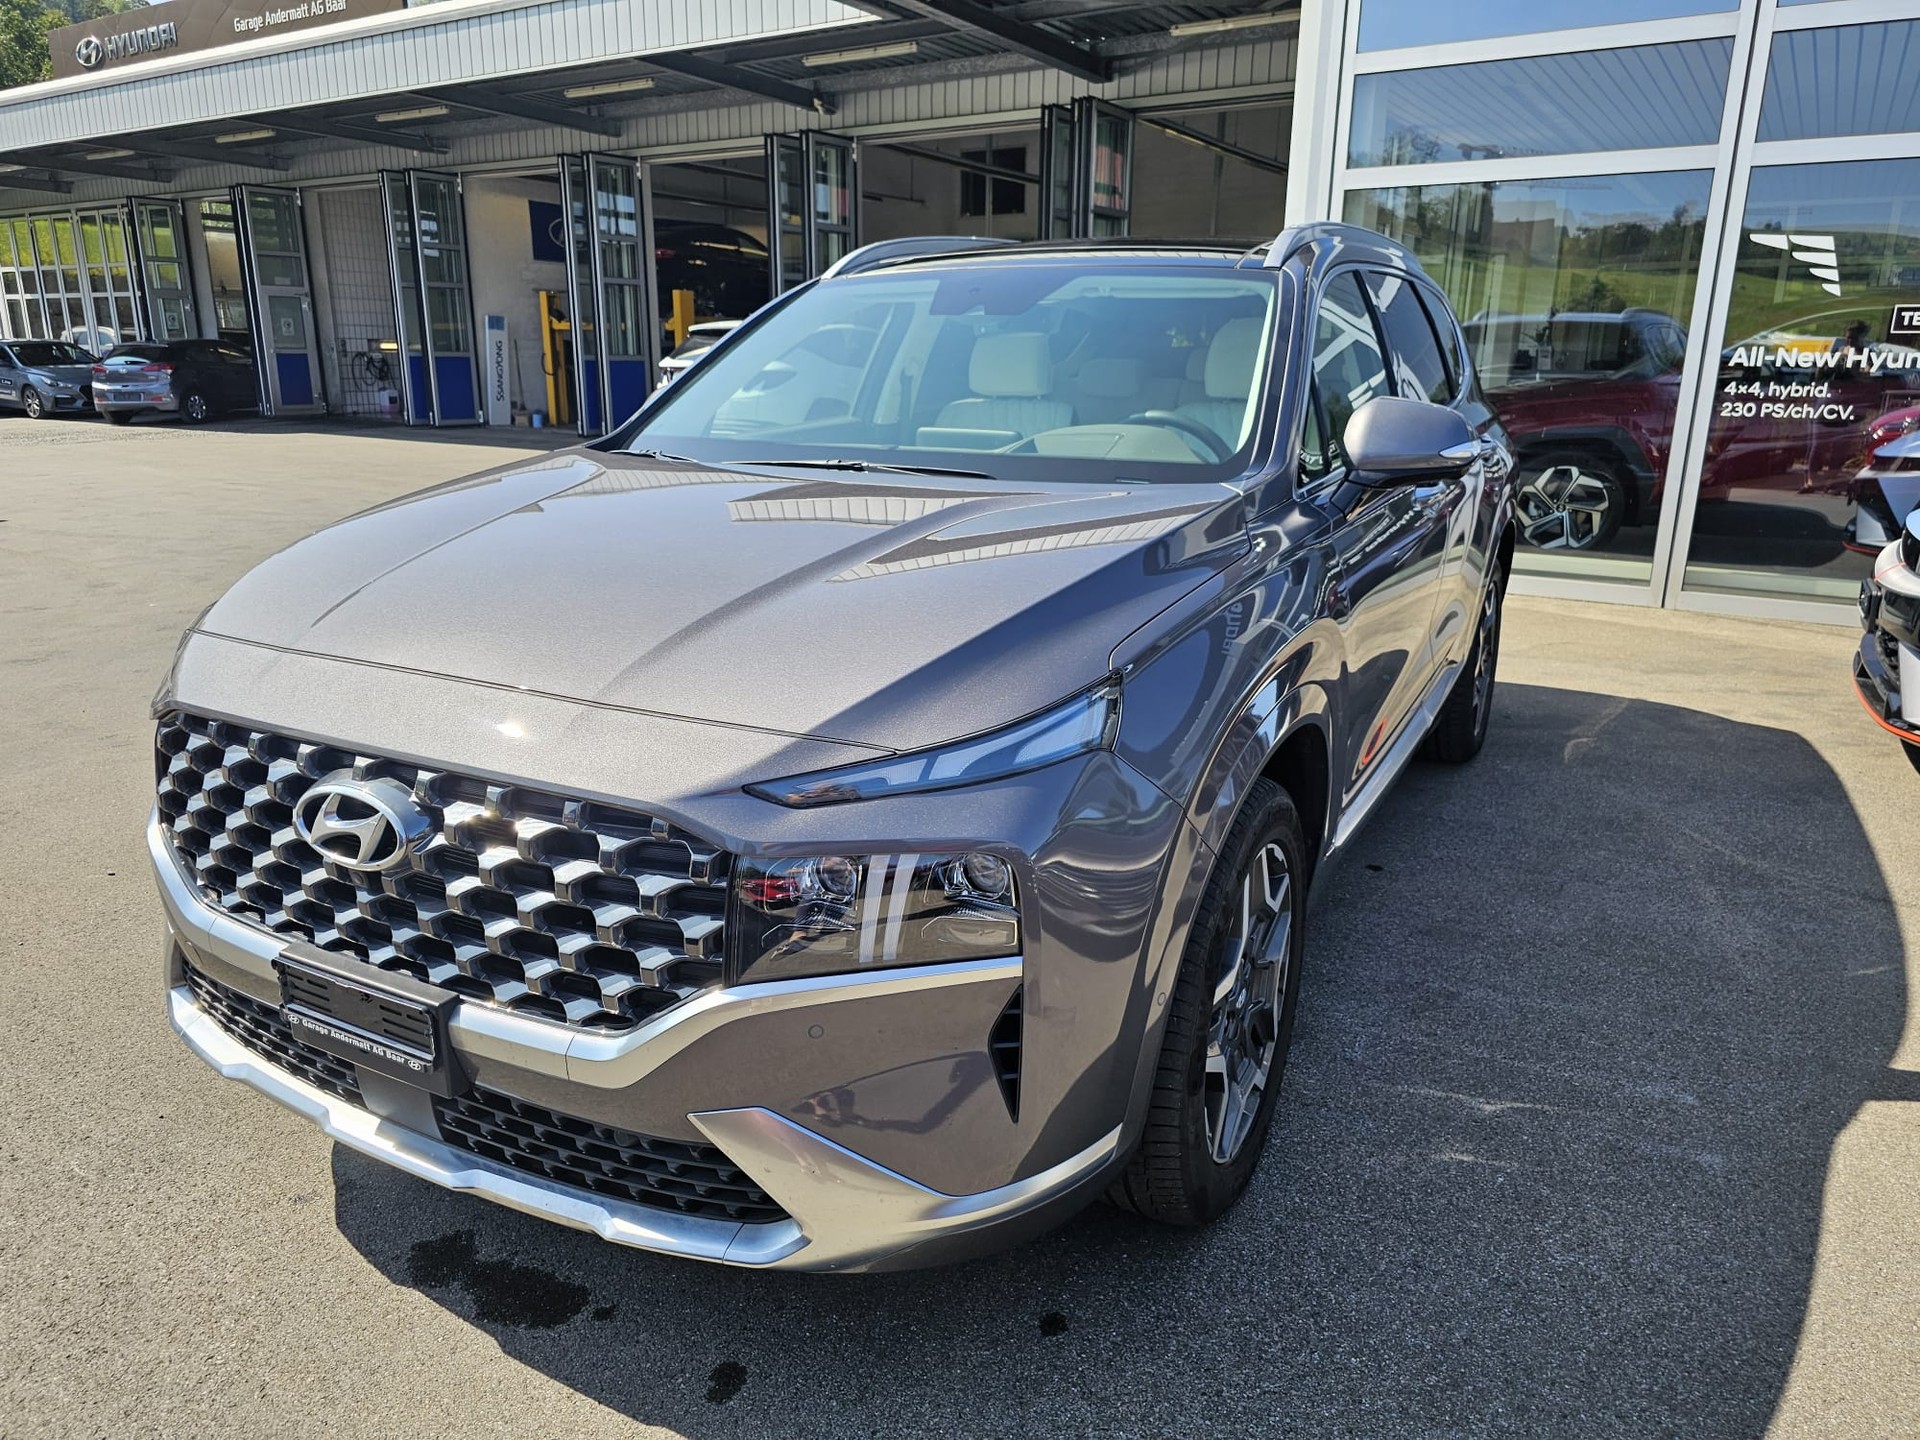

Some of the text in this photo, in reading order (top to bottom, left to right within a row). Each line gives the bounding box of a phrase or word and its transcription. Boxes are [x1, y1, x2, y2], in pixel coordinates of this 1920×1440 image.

[234, 0, 347, 32] Garage Andermatt AG Baar
[105, 22, 177, 60] HYUNDAI
[1728, 346, 1920, 374] All-New Hyun
[1768, 381, 1832, 400] hybrid.
[1720, 402, 1855, 421] 230 PS/ch/CV.
[302, 1019, 405, 1063] Garage Andermatt AG Baar
